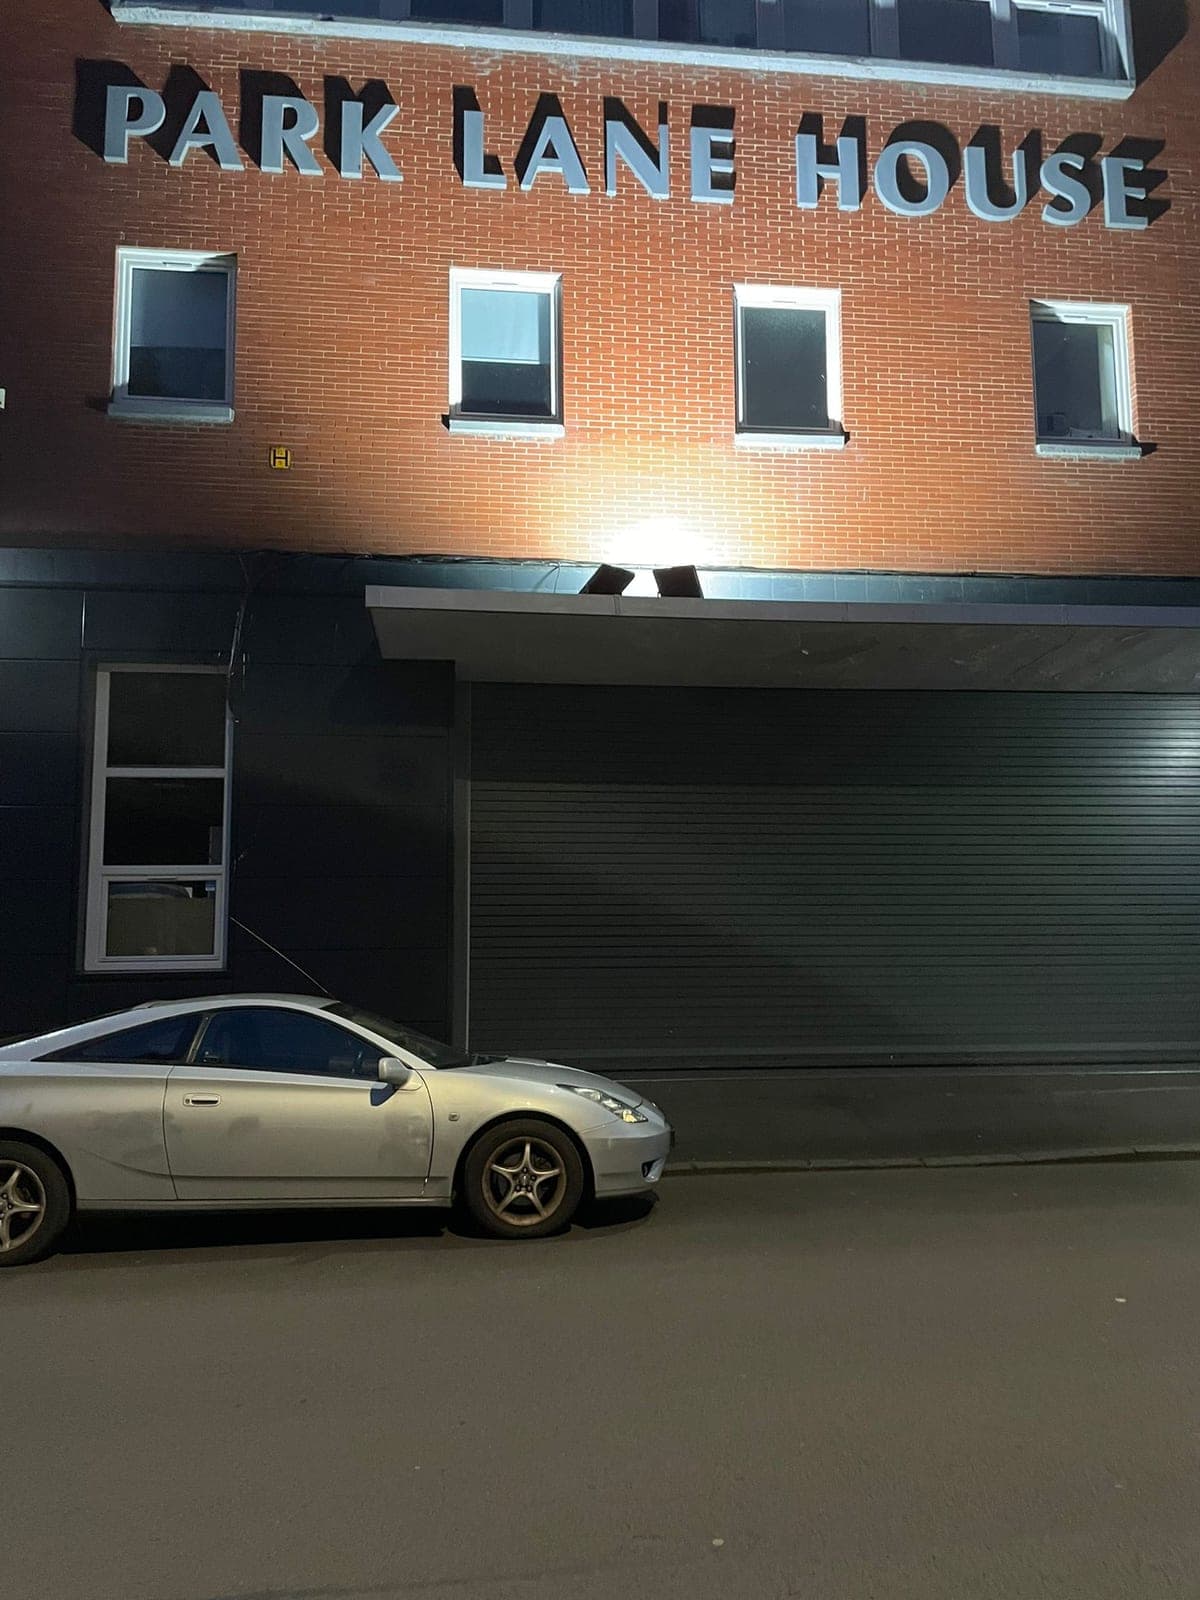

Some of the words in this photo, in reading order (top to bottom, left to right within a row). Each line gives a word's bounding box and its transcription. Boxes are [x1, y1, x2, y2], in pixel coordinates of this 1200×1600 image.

[103, 84, 403, 181] PARK
[462, 109, 735, 204] LANE
[794, 133, 1149, 230] HOUSE
[273, 449, 289, 467] H
